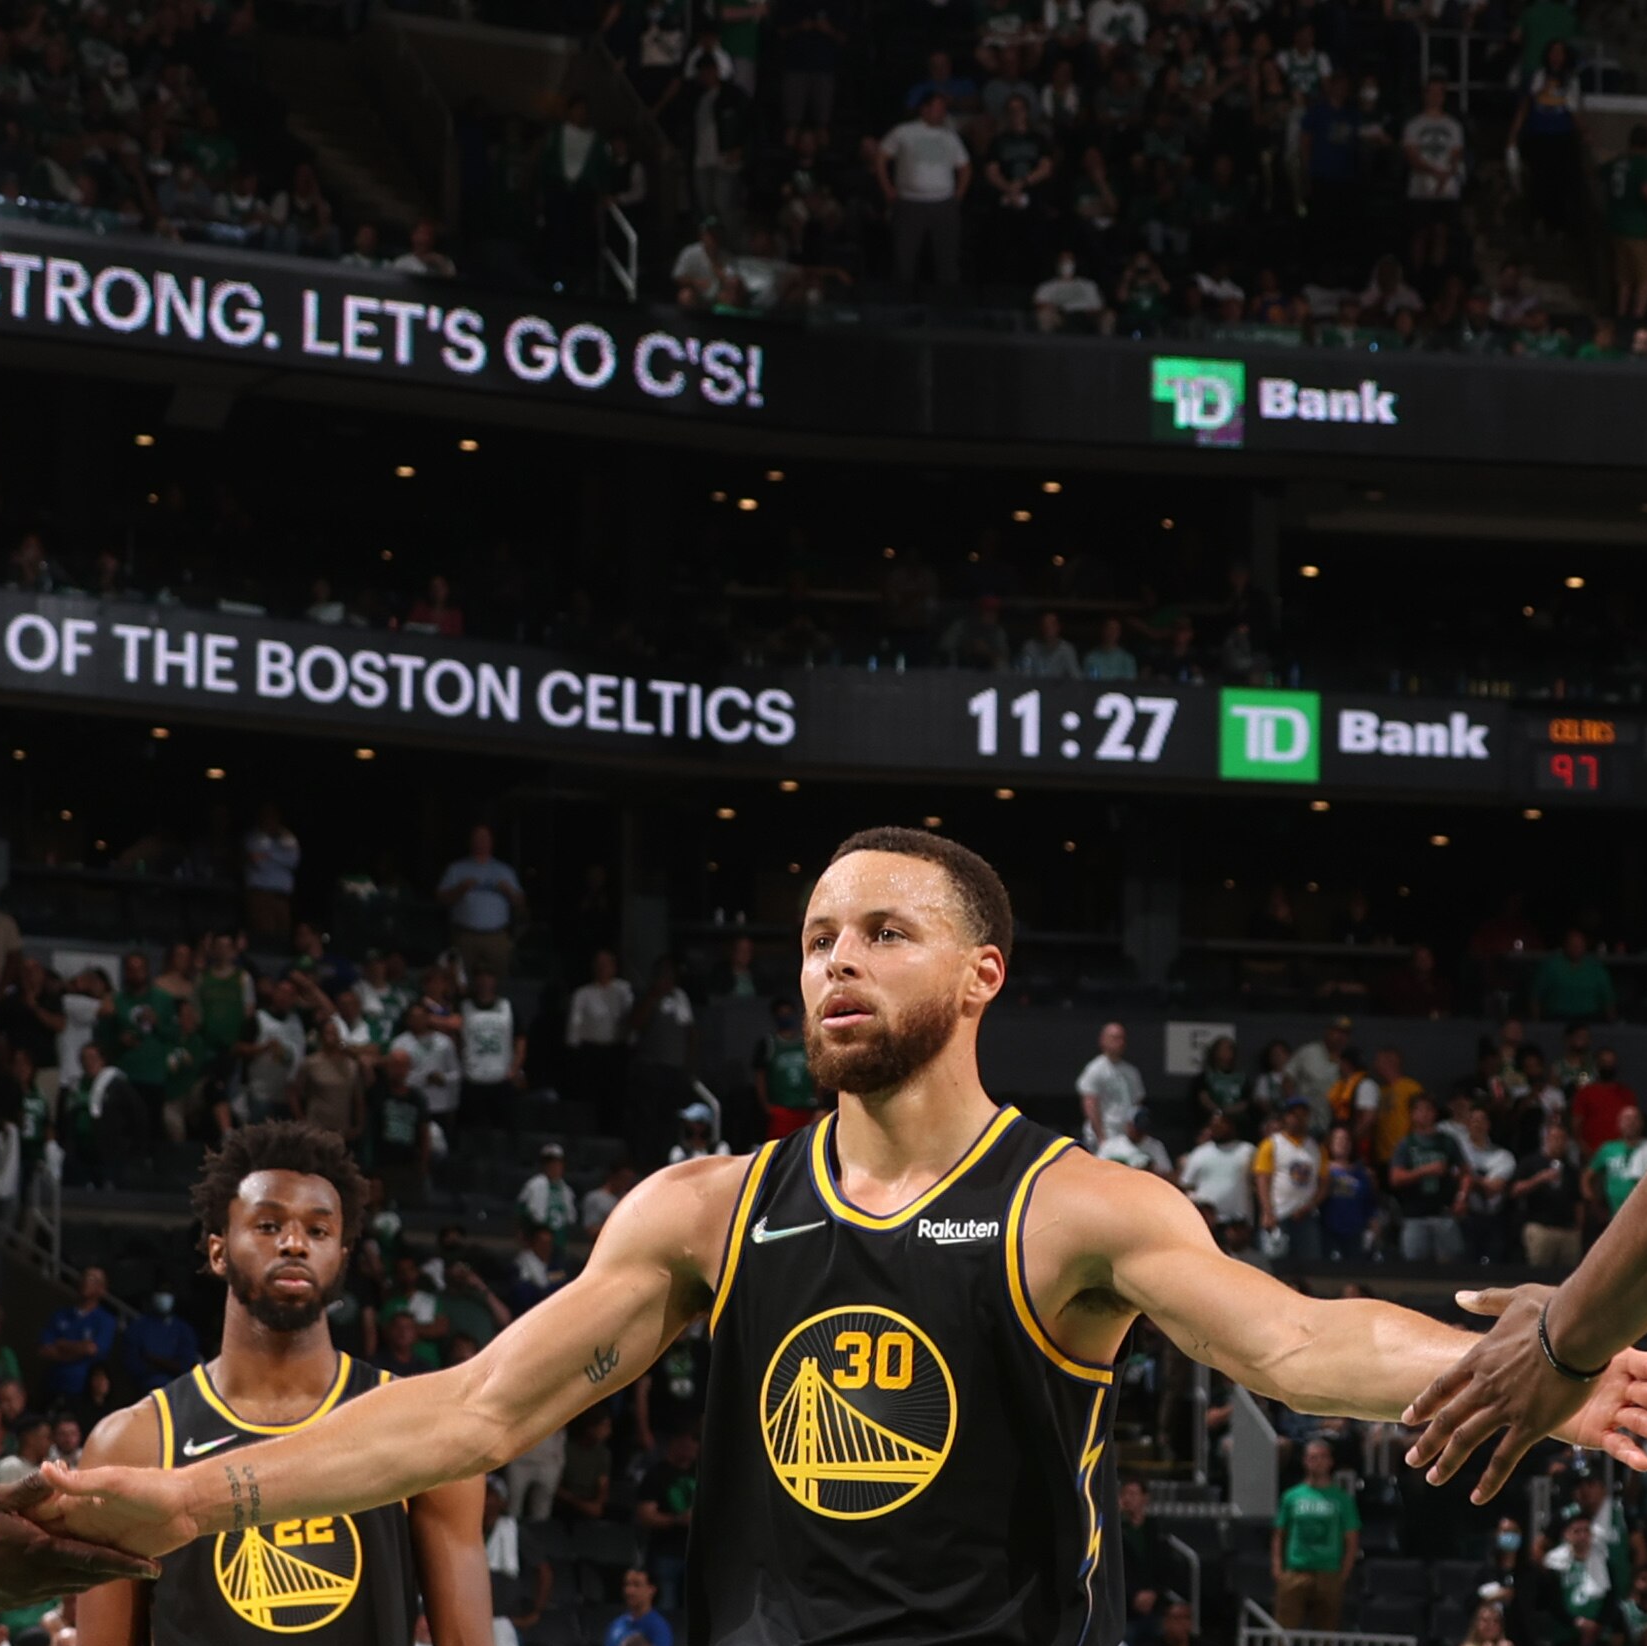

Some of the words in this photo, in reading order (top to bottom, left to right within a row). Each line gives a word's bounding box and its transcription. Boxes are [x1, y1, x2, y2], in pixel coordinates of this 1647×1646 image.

[302, 289, 487, 374] LET'S
[504, 316, 617, 389] GO
[634, 332, 764, 408] C'S!
[1164, 376, 1234, 430] TD
[1259, 377, 1397, 425] Bank
[4, 613, 98, 677] OF
[112, 624, 239, 693] THE
[256, 640, 520, 722] BOSTON
[536, 670, 797, 746] CELTICS
[968, 687, 1179, 763] 11:27
[1229, 705, 1311, 763] TD
[1338, 709, 1490, 759] Bank
[1550, 754, 1598, 789] 97
[917, 1218, 999, 1241] Rakuten
[833, 1330, 914, 1390] 30
[274, 1515, 335, 1547] 22
